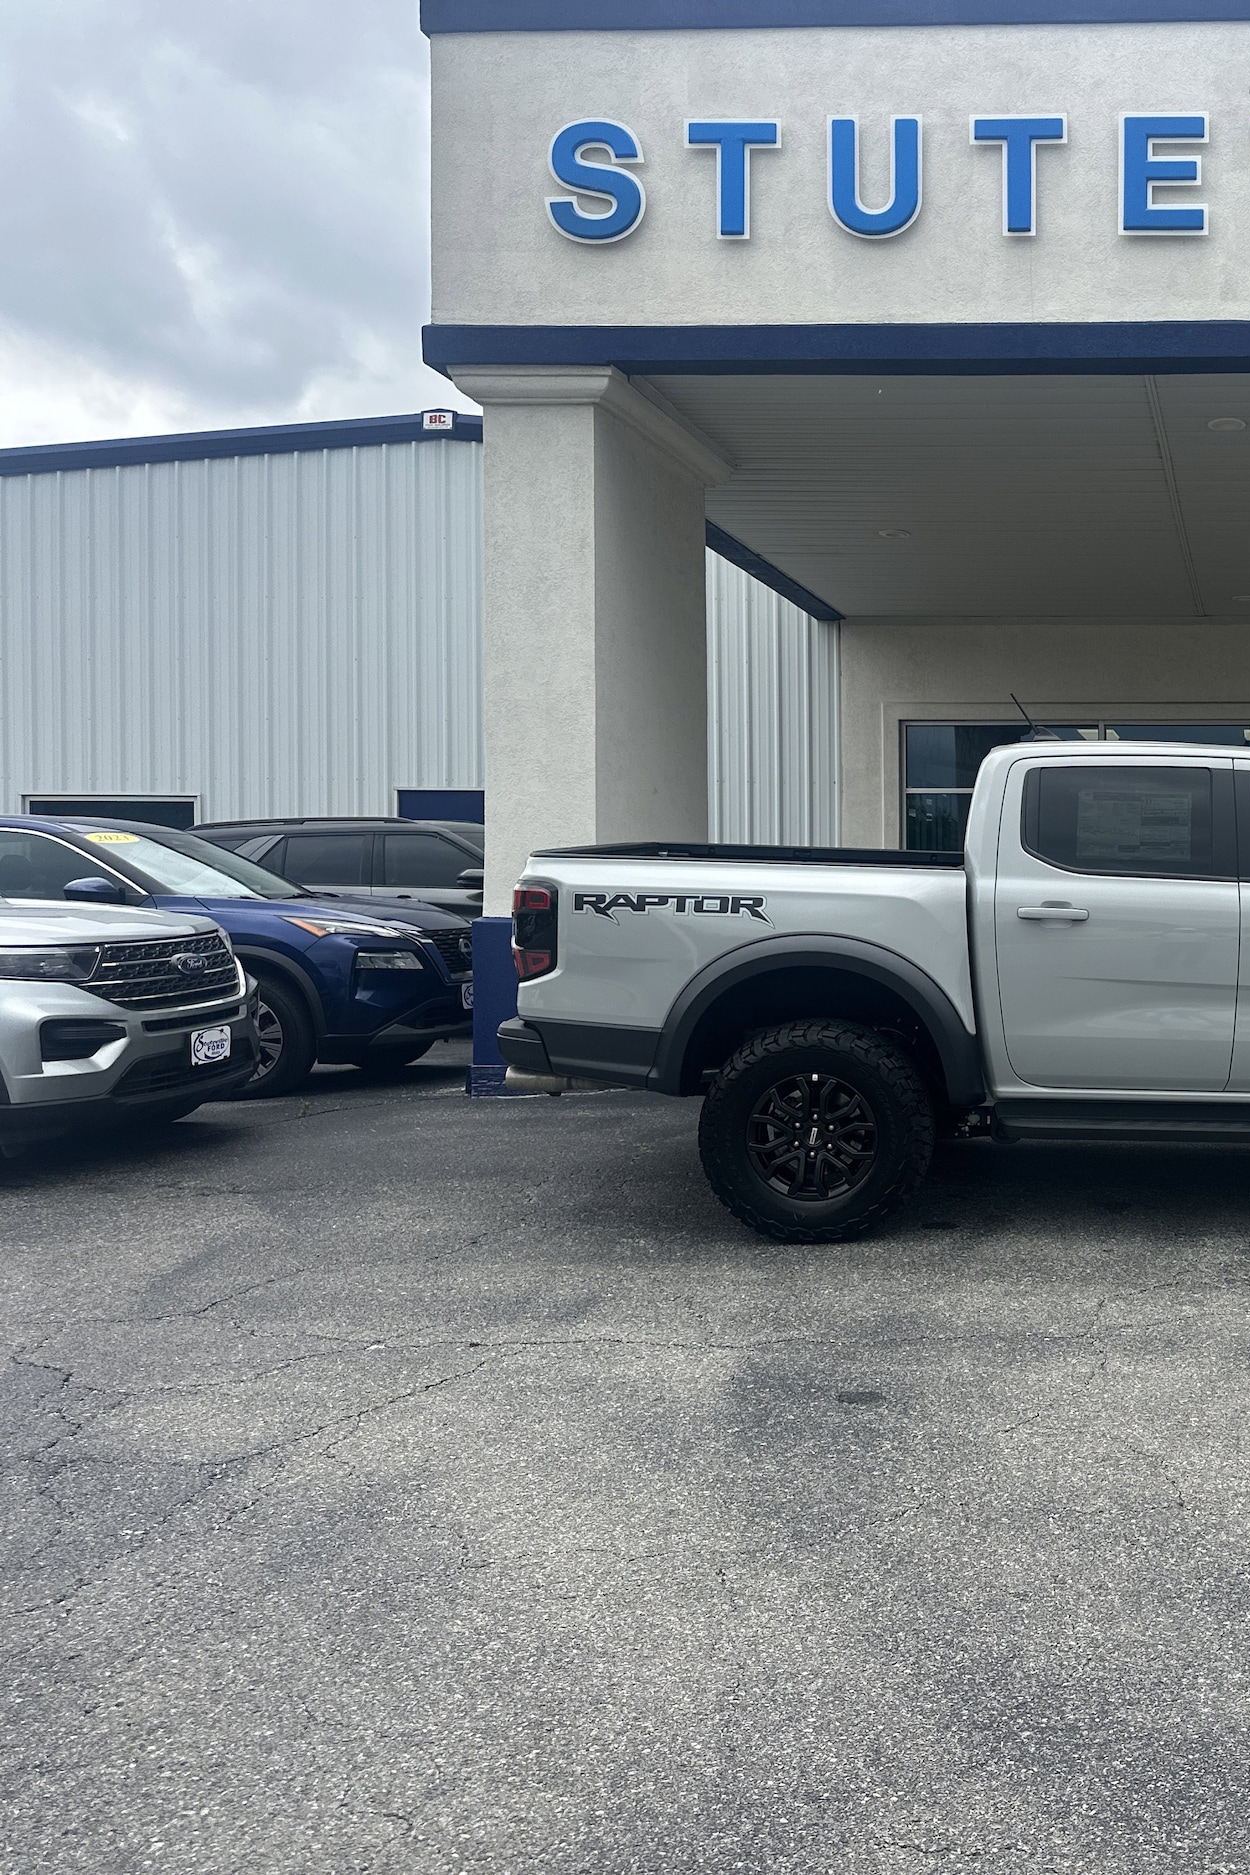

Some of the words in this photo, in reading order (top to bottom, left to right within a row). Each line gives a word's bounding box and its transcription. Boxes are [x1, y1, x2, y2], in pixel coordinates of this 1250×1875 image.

[429, 414, 446, 424] BC
[572, 891, 776, 930] RAPTOR
[207, 1042, 225, 1052] FORD
